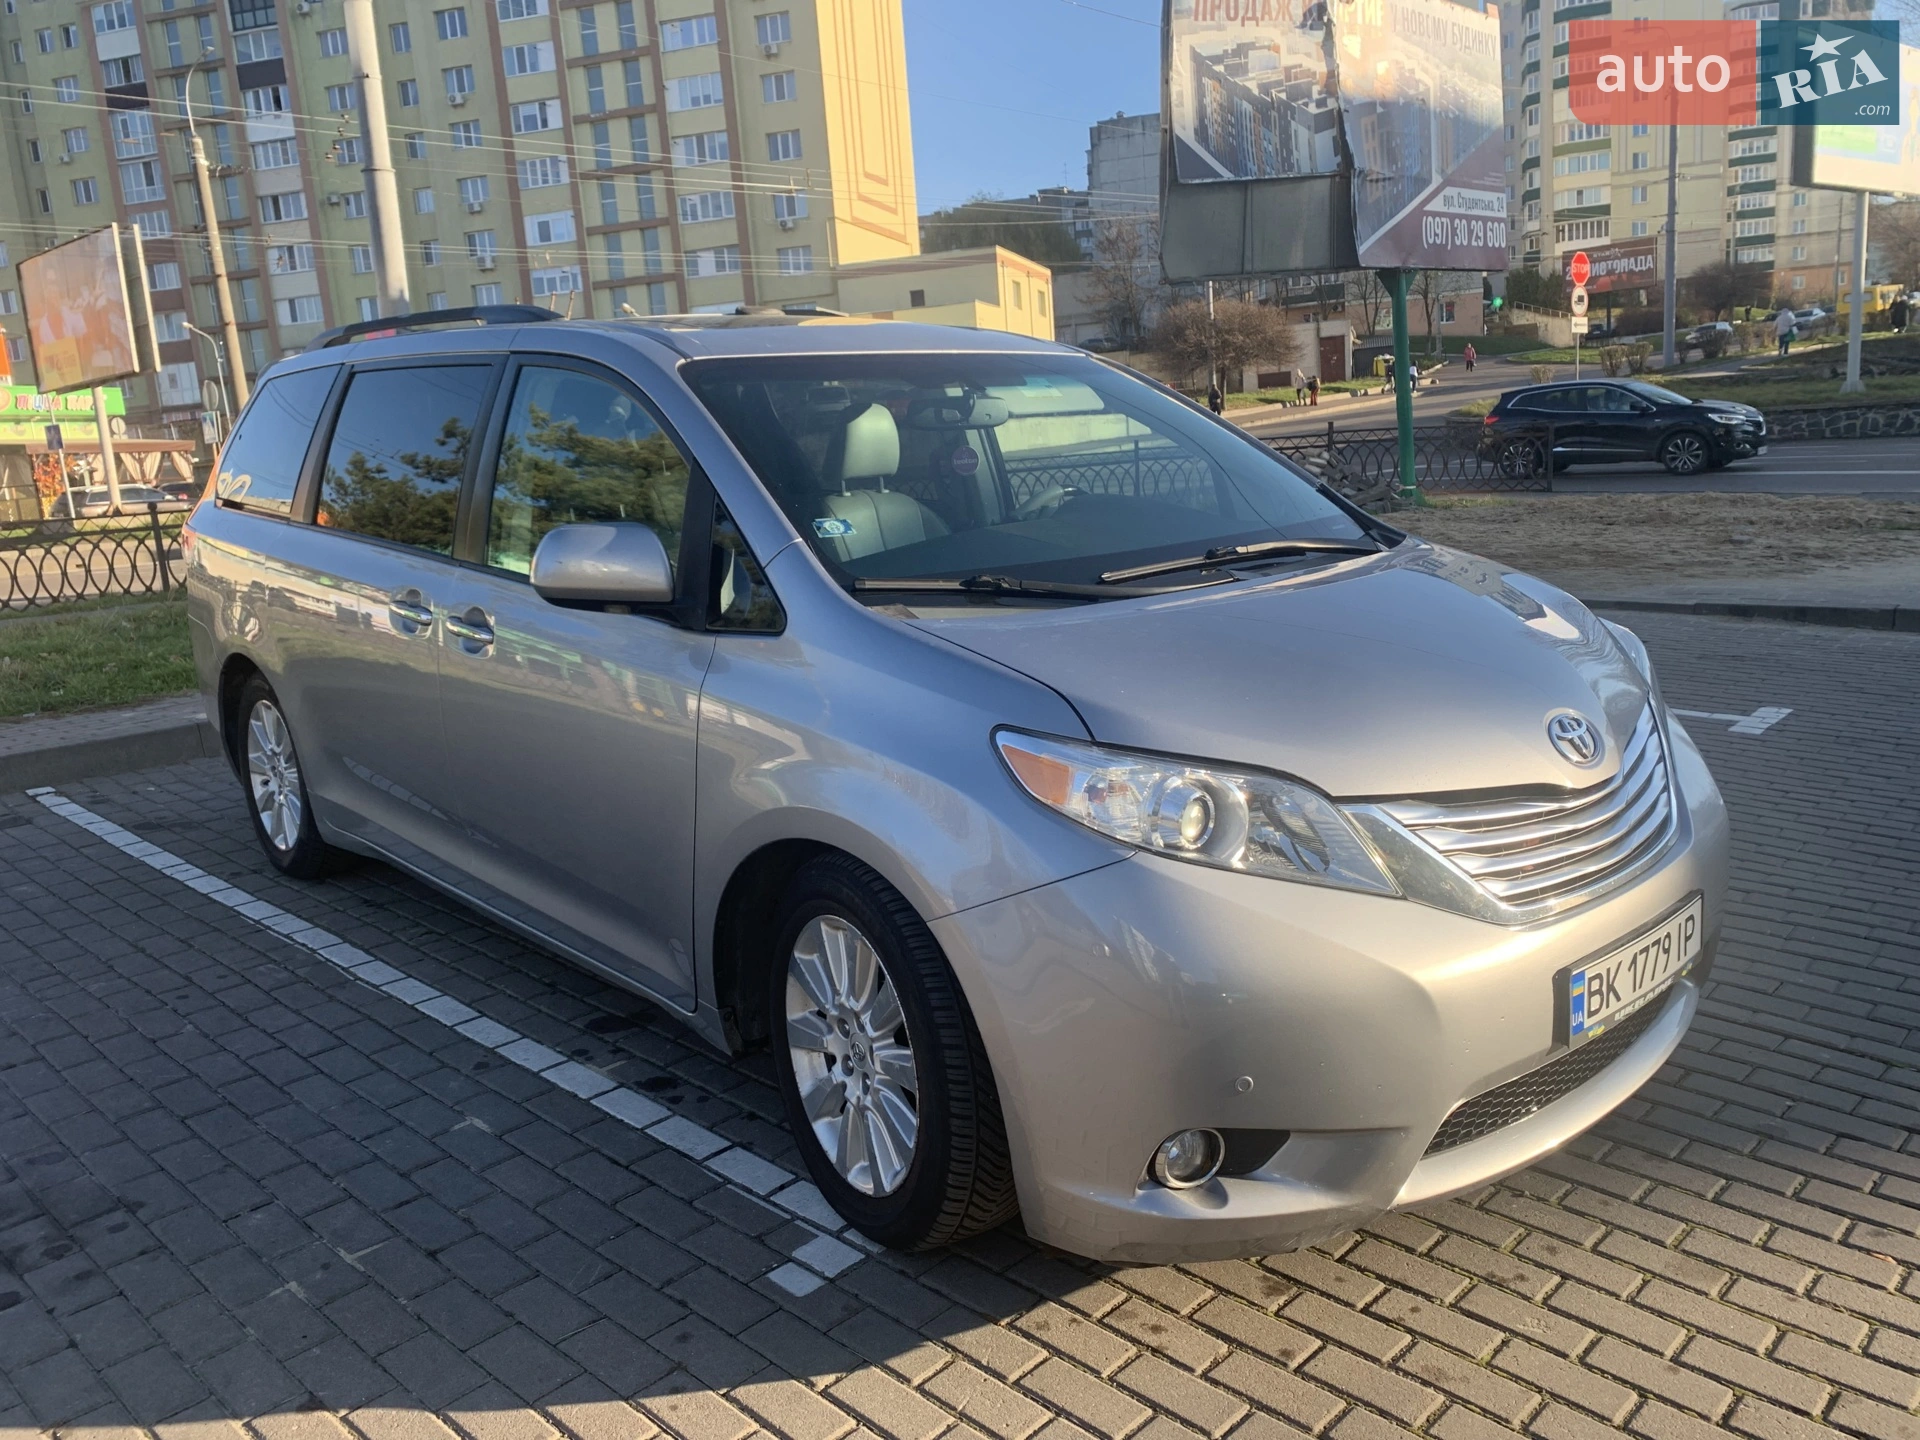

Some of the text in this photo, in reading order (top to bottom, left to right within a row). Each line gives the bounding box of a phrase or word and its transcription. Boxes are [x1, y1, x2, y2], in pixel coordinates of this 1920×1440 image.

[1193, 0, 1295, 28] ПРОДАЖ
[1401, 6, 1448, 47] НОВОМУ
[1451, 21, 1497, 61] БУДИНКУ
[1443, 191, 1504, 213] вул. Студентська, 24
[1422, 215, 1507, 250] (097) 30 29 600
[1572, 263, 1590, 273] STOP
[1587, 913, 1696, 1020] BK 1779 IP
[1614, 974, 1676, 1022] UKRAINE
[1572, 1010, 1584, 1027] UA
